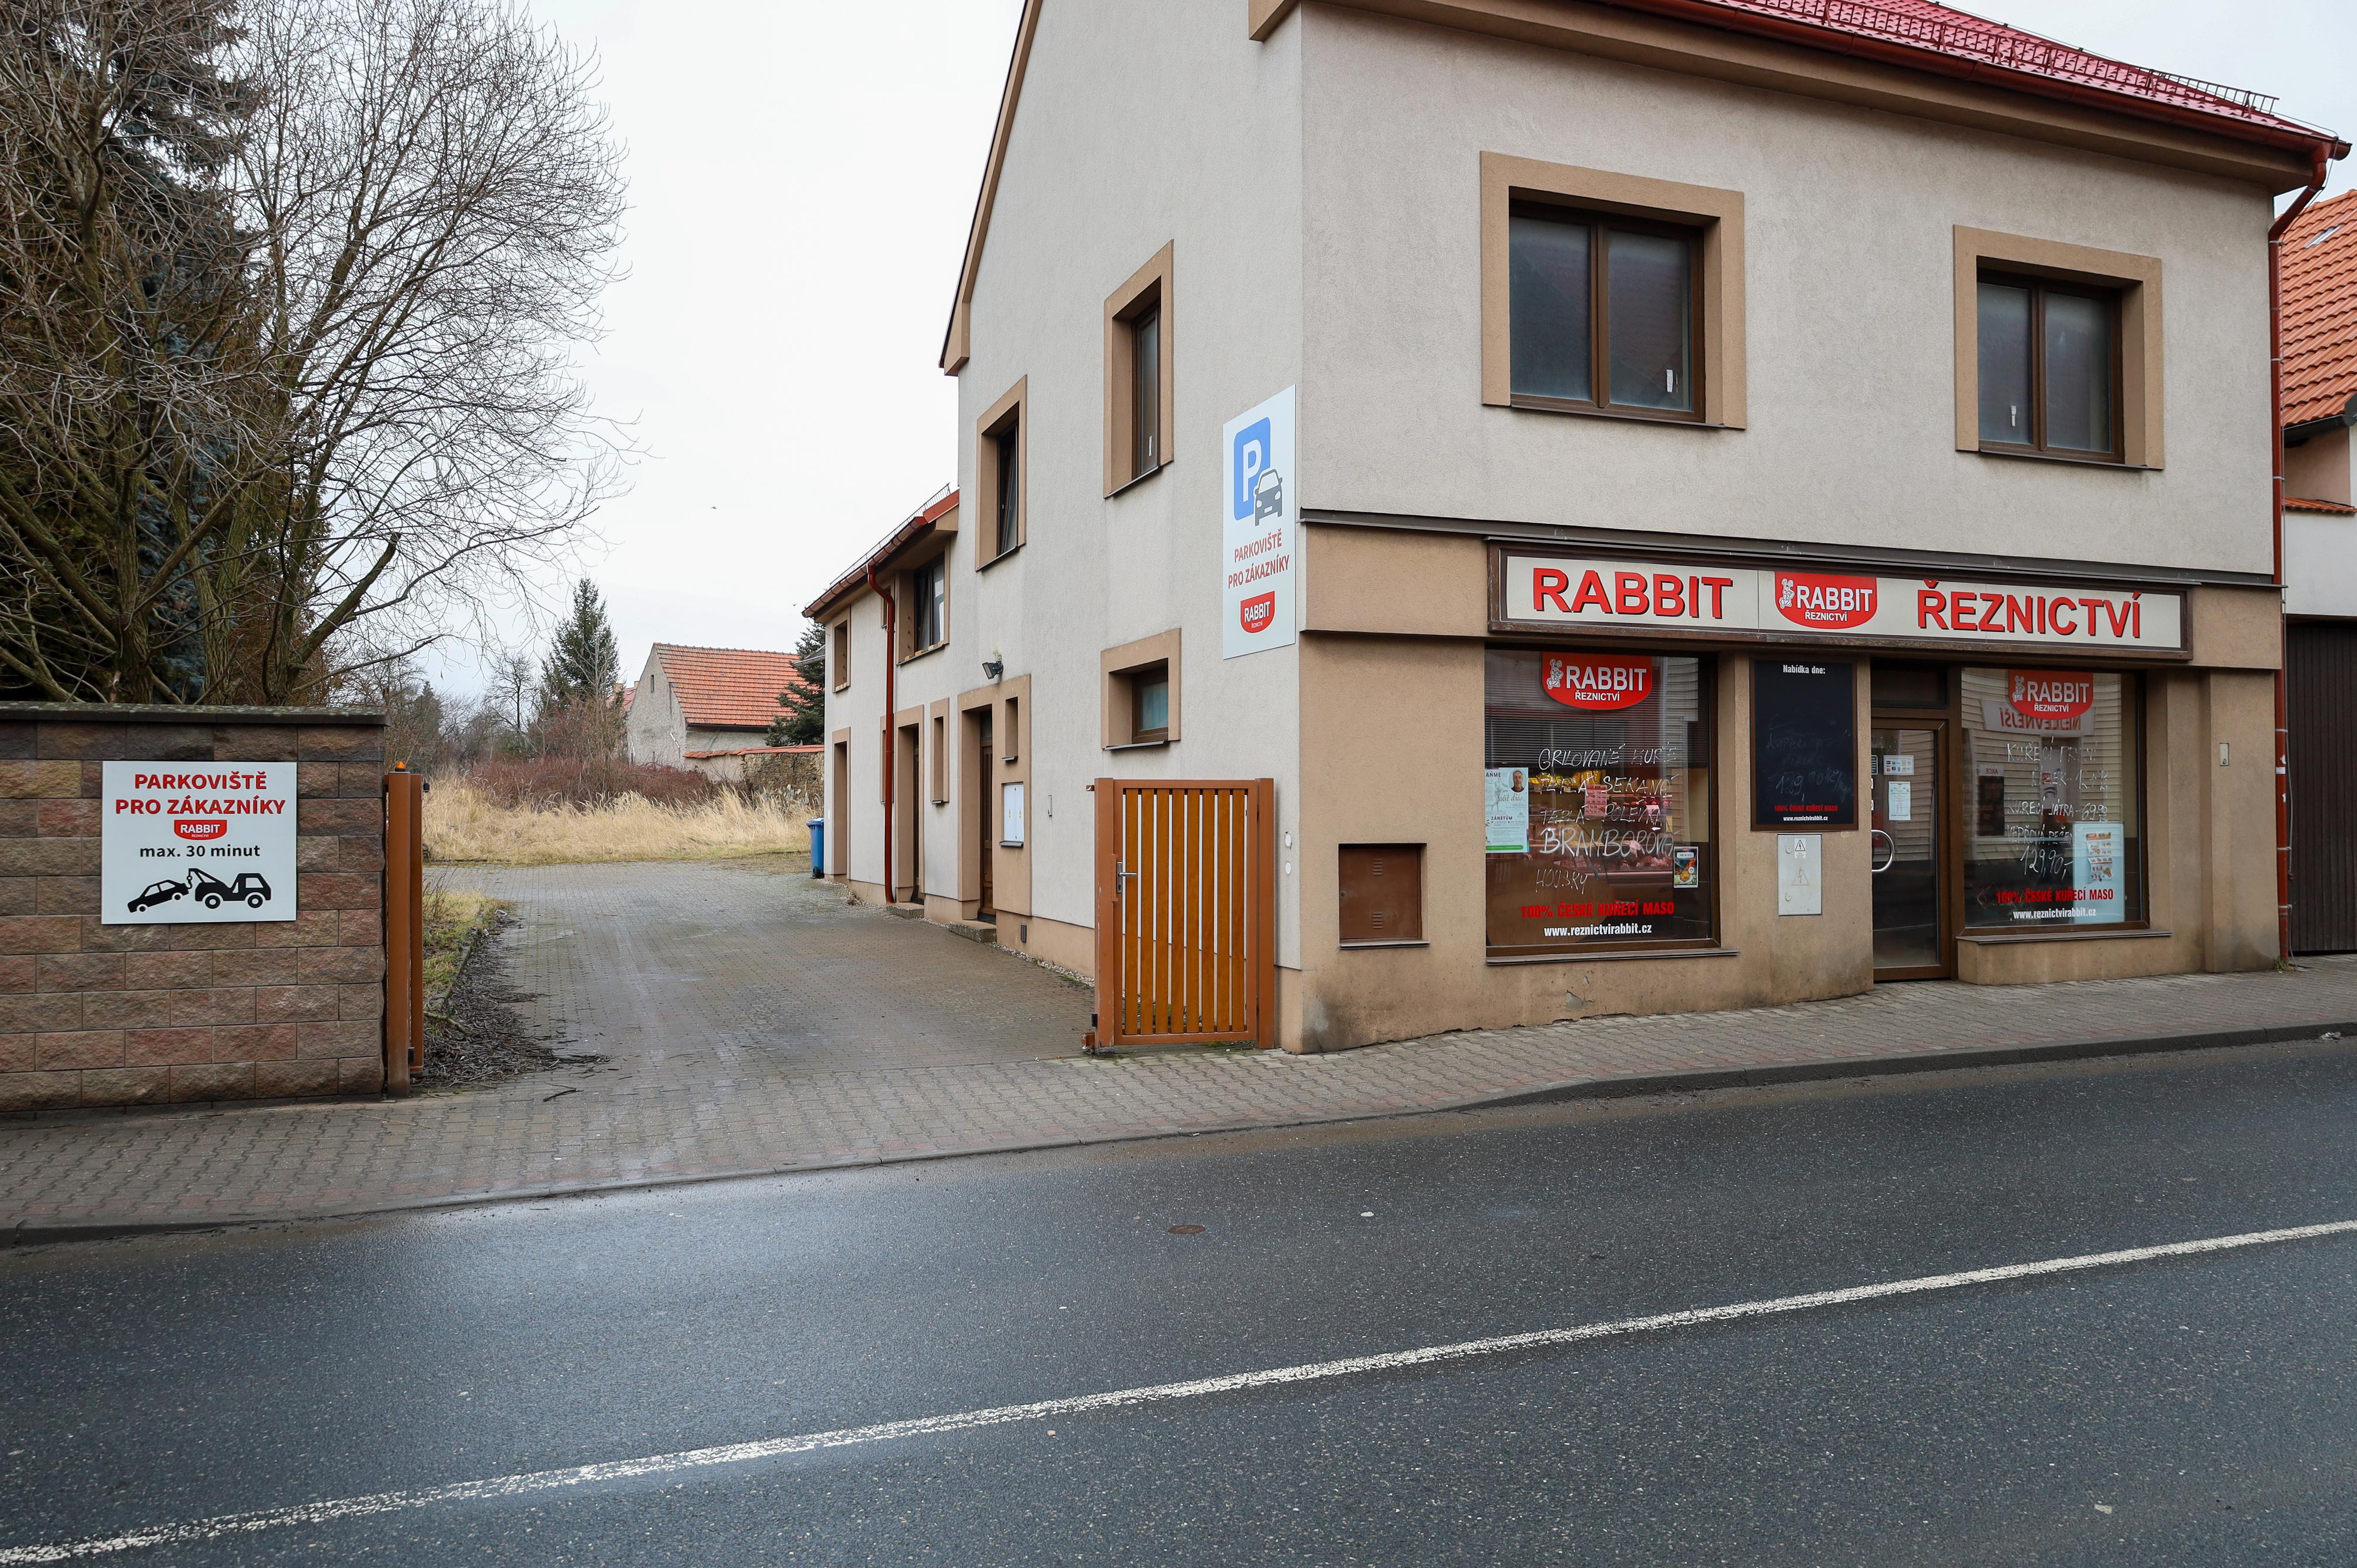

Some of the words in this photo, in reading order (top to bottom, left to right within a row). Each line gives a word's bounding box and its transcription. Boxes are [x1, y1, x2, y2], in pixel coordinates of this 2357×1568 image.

[1234, 528, 1282, 563] PARKOVIŠTĚ
[1228, 571, 1243, 589] PRO
[1245, 553, 1289, 583] ZÁKAZNÍKY
[1533, 567, 1733, 619] RABBIT
[1797, 585, 1873, 612] RABBIT
[1244, 601, 1270, 623] RABBIT
[1805, 610, 1847, 622] ŘEZNICTVÍ
[1917, 579, 2141, 638] ŘEZNICTVÍ
[1566, 665, 1647, 691] RABBIT
[1782, 664, 1810, 674] Nabídka
[1811, 665, 1825, 674] dne:
[1574, 690, 1620, 701] ŘEZNICTVÍ
[2027, 681, 2089, 703] RABBIT
[2034, 703, 2069, 712] ŘEZNICTVÍ
[1539, 744, 1625, 770] GRILOVANÉ
[134, 770, 268, 790] PARKOVIŠTĚ
[115, 798, 161, 814] PRO
[167, 795, 286, 814] ZÁKAZNÍKY
[180, 824, 220, 833] RABBIT
[140, 847, 181, 857] max.
[186, 845, 206, 857] 30
[210, 844, 260, 857] minut
[1539, 827, 1686, 857] BRAMBOROVÁ
[1996, 891, 2022, 903] 100%
[2024, 887, 2052, 902] ČESKÉ
[2055, 887, 2087, 902] KUŘECÍ
[2089, 889, 2114, 900] MASO
[1520, 905, 1553, 919] 100%
[1557, 900, 1593, 917] ČESKÉ
[1597, 899, 1640, 916] KUŘECÍ
[1643, 902, 1675, 915] MASO
[2013, 907, 2097, 919] www.reznictvirabbit.cz
[1544, 923, 1652, 937] www.reznictvirabbit.cz
